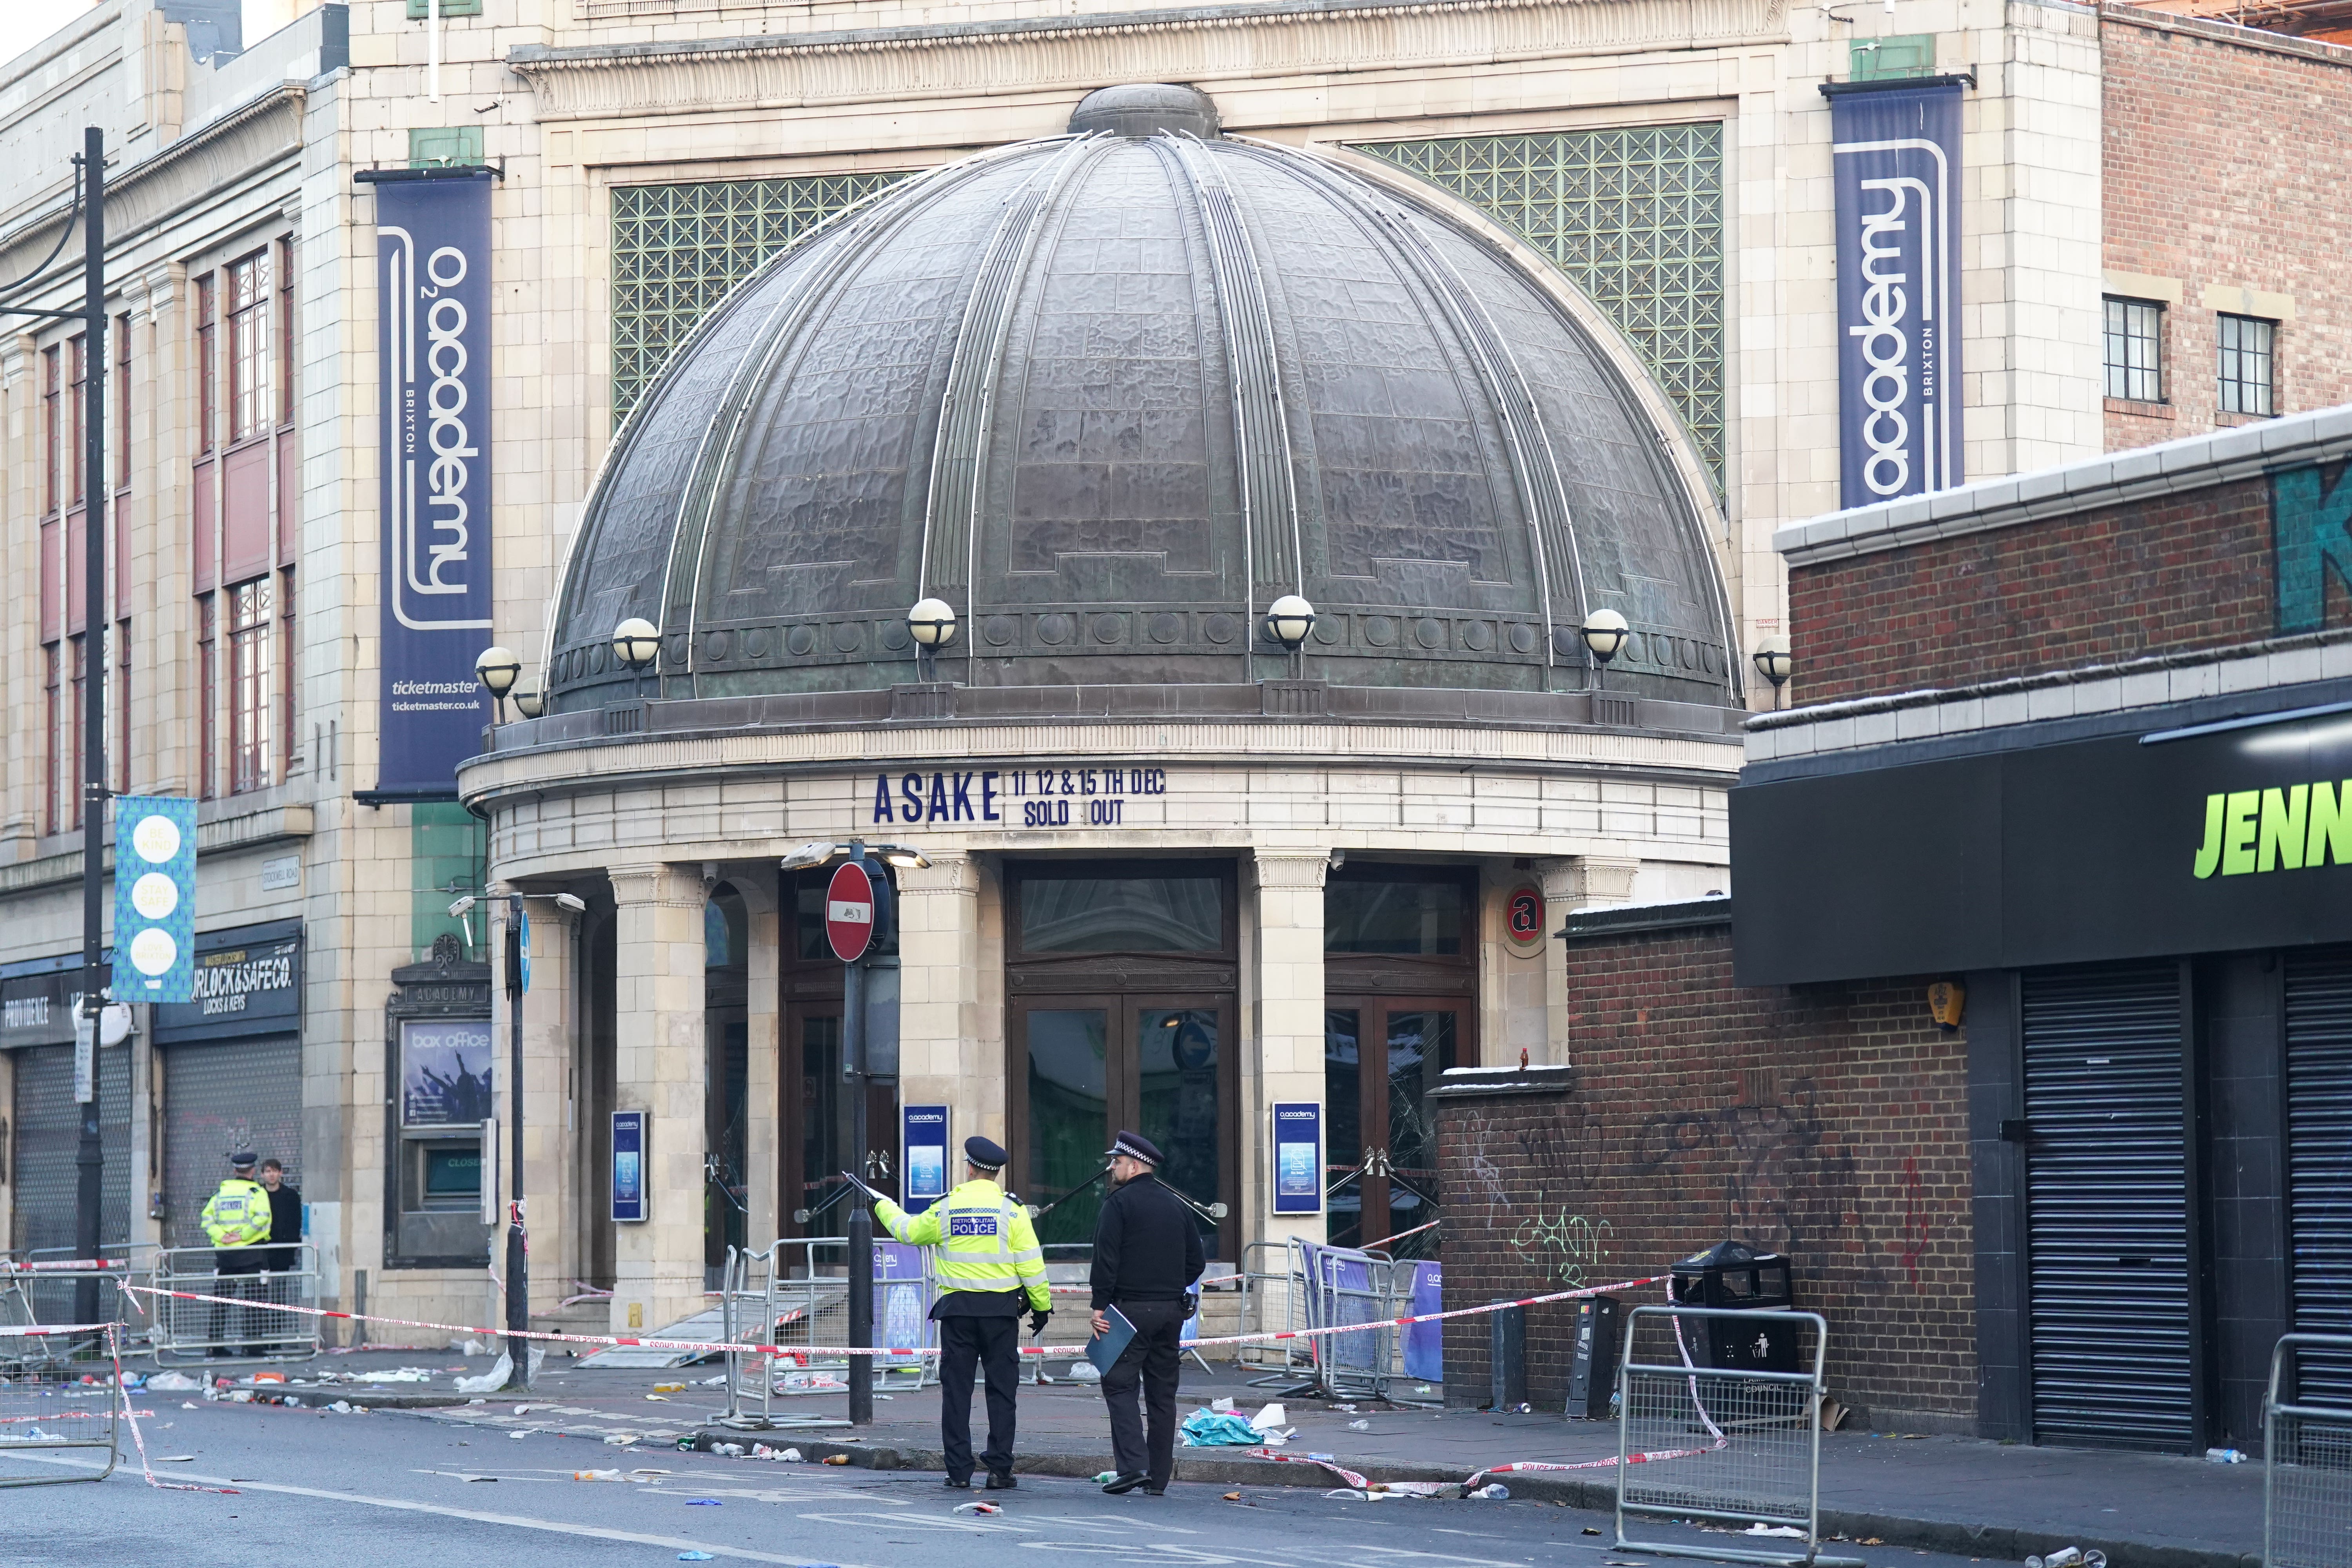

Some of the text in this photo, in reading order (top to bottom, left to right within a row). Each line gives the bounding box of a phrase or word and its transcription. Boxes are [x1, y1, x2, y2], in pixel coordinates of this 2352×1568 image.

[1923, 328, 1933, 396] BRIXTON
[406, 389, 416, 454] BRIXTON
[392, 680, 479, 695] ticketmaster
[392, 700, 480, 711] ticketmaster.co.uk
[1036, 769, 1054, 795] 12
[1062, 769, 1075, 795] &
[1132, 769, 1164, 794] DEC
[874, 771, 1000, 823] ASAKE
[1024, 799, 1124, 827] SOLD OUT
[149, 828, 164, 838] BE
[142, 840, 171, 850] KIND
[286, 867, 298, 878] ROAD
[141, 885, 169, 895] STAY
[141, 897, 169, 907] SAFE
[136, 951, 171, 960] BRIXTON
[417, 987, 474, 1000] ACADEMY
[203, 994, 246, 1015] LOCKS & KEYS
[5, 996, 49, 1028] PROVIDENCE
[412, 1031, 489, 1048] box office
[448, 1158, 481, 1167] CLOSE
[952, 1224, 995, 1234] POLICE
[1746, 1384, 1782, 1393] COUNCIL
